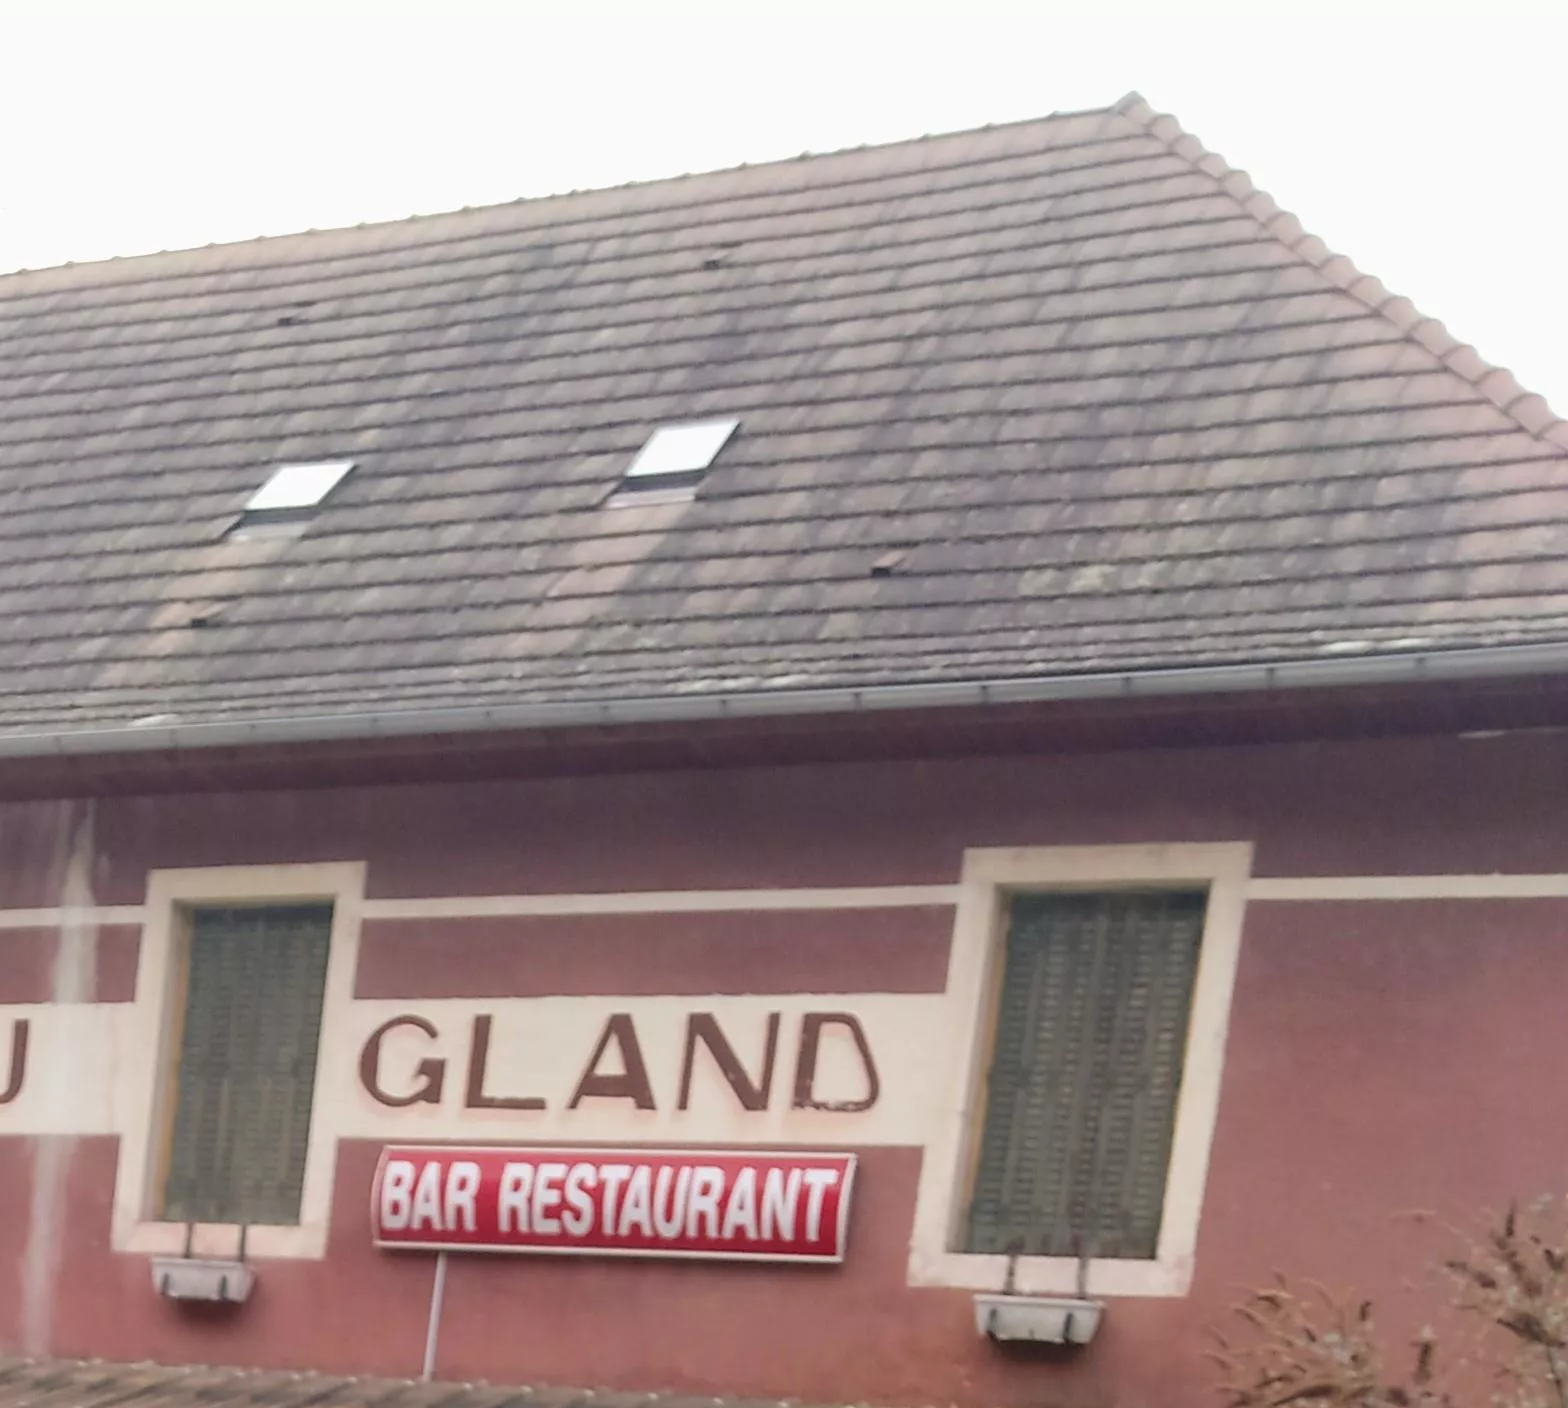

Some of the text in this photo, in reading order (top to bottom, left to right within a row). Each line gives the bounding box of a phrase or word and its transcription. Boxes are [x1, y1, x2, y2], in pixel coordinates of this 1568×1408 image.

[358, 1011, 880, 1113] GLAND
[380, 1160, 840, 1243] BAR RESTAURANT
